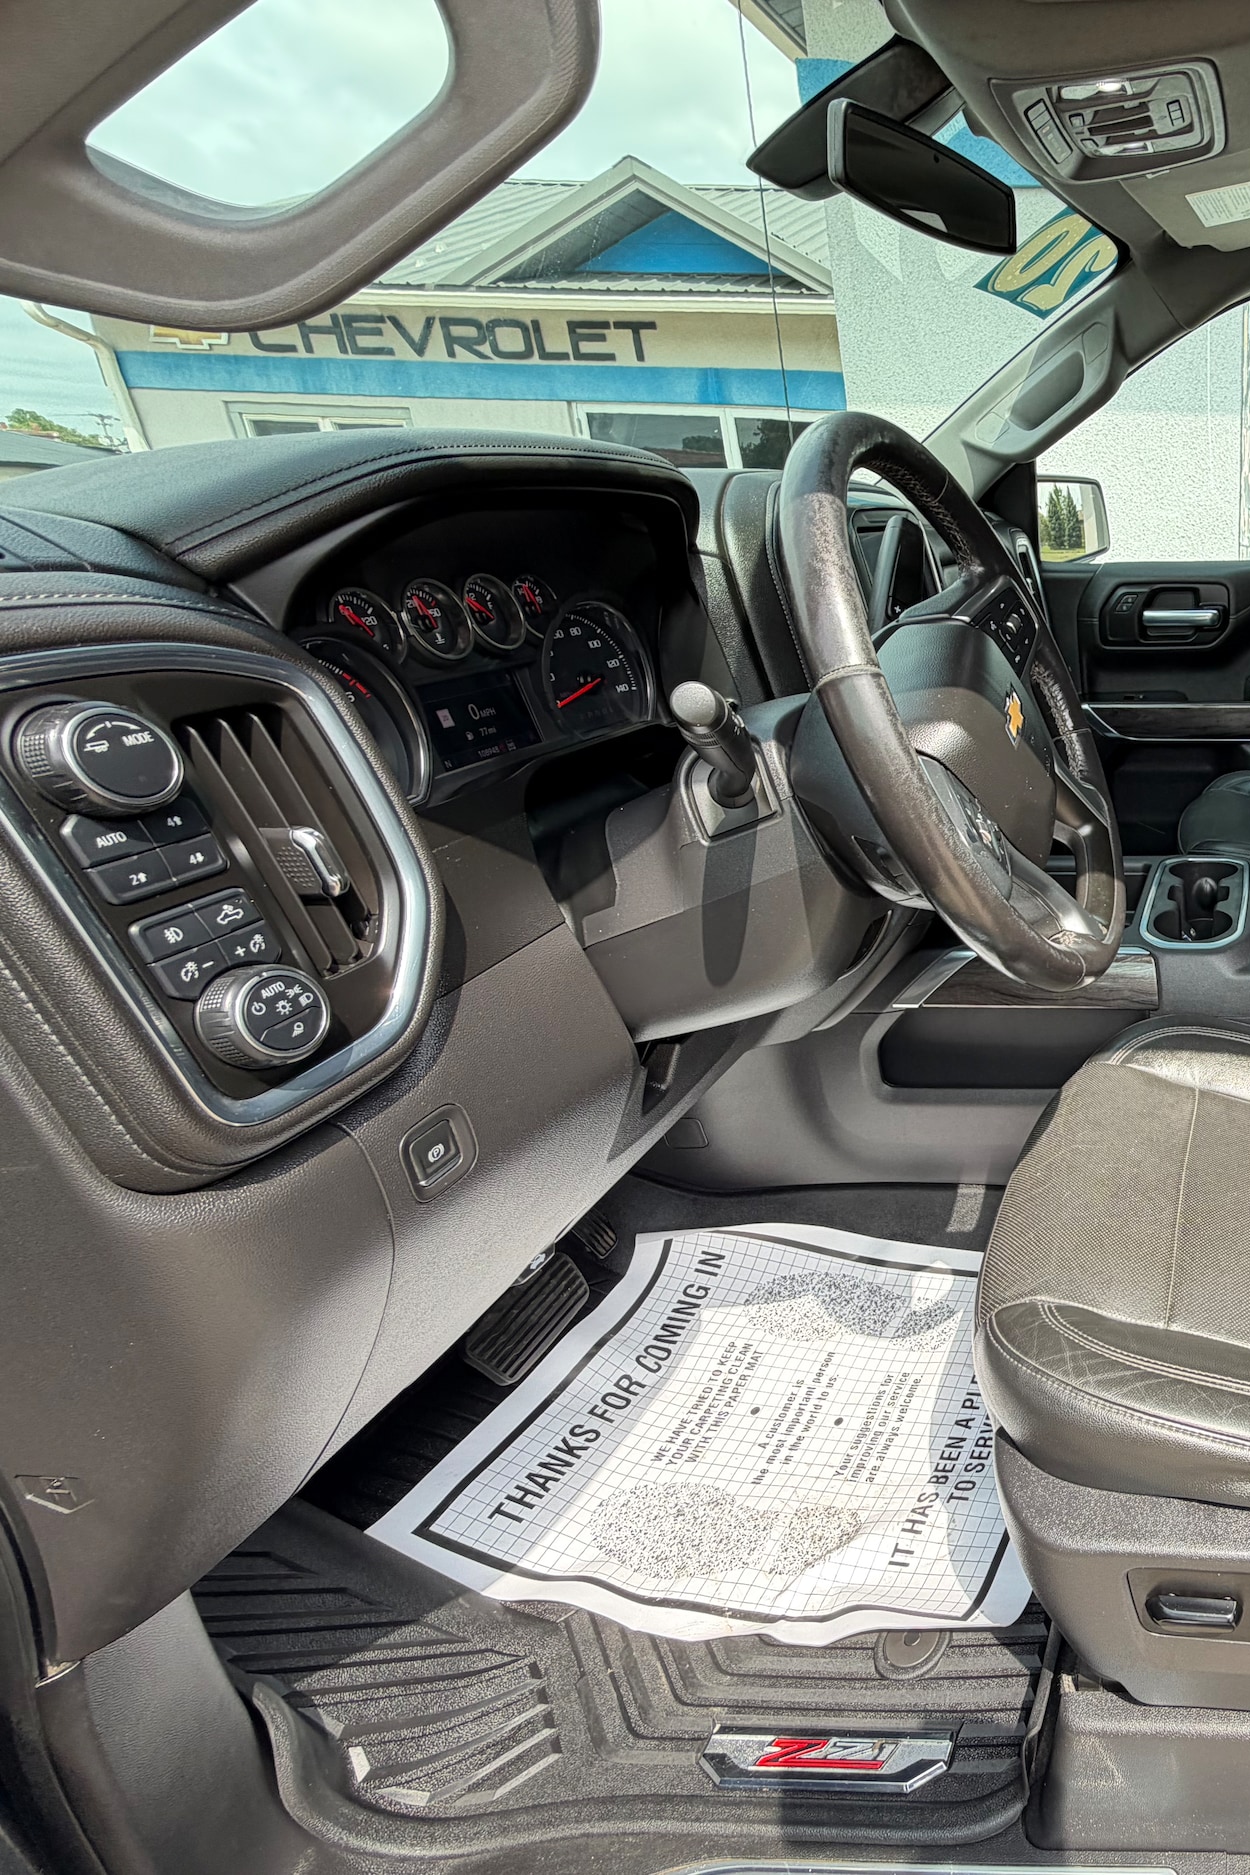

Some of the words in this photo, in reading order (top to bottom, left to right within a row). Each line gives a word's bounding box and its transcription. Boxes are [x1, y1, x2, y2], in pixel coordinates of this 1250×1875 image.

[248, 313, 657, 362] CHEVROLET
[569, 626, 582, 636] 80
[587, 639, 602, 649] 100
[606, 658, 620, 669] 120
[615, 683, 630, 693] 140
[121, 731, 155, 747] MODE
[95, 831, 128, 849] AUTO
[260, 981, 286, 999] AUTO
[487, 1424, 601, 1524] THANKS
[587, 1374, 647, 1424] FOR
[635, 1283, 711, 1374] COMING
[694, 1250, 726, 1277] IN
[650, 1445, 671, 1462] WE
[665, 1418, 693, 1444] HAVE
[686, 1386, 713, 1415] TRIED
[707, 1369, 723, 1383] TO
[717, 1341, 738, 1366] KEEP
[665, 1437, 695, 1466] YOUR
[690, 1377, 733, 1435] CARPETING
[728, 1342, 754, 1375] CLEAN
[684, 1436, 712, 1463] WITH
[705, 1411, 730, 1433] THIS
[724, 1373, 751, 1408] PAPER
[744, 1350, 764, 1371] MAT
[751, 1468, 769, 1485] the
[766, 1439, 788, 1465] most
[780, 1386, 817, 1436] important
[812, 1351, 836, 1384] person
[757, 1442, 770, 1450] A
[765, 1391, 798, 1439] customer
[792, 1379, 805, 1388] is
[779, 1455, 794, 1465] in
[788, 1435, 805, 1451] the
[801, 1403, 823, 1433] world
[816, 1391, 830, 1401] to
[825, 1374, 840, 1388] us.
[832, 1453, 854, 1477] Your
[850, 1389, 887, 1451] suggestions
[880, 1374, 894, 1387] for
[846, 1430, 885, 1483] improving
[878, 1410, 891, 1427] our
[887, 1372, 911, 1407] service
[865, 1465, 880, 1483] are
[876, 1426, 900, 1462] always
[894, 1375, 924, 1423] welcome.
[954, 1417, 976, 1430] A
[927, 1436, 968, 1485] BEEN
[946, 1479, 977, 1504] TO
[963, 1413, 994, 1474] SERV
[900, 1491, 940, 1535] HAS
[887, 1542, 915, 1568] IT
[754, 1737, 900, 1771] Z71
